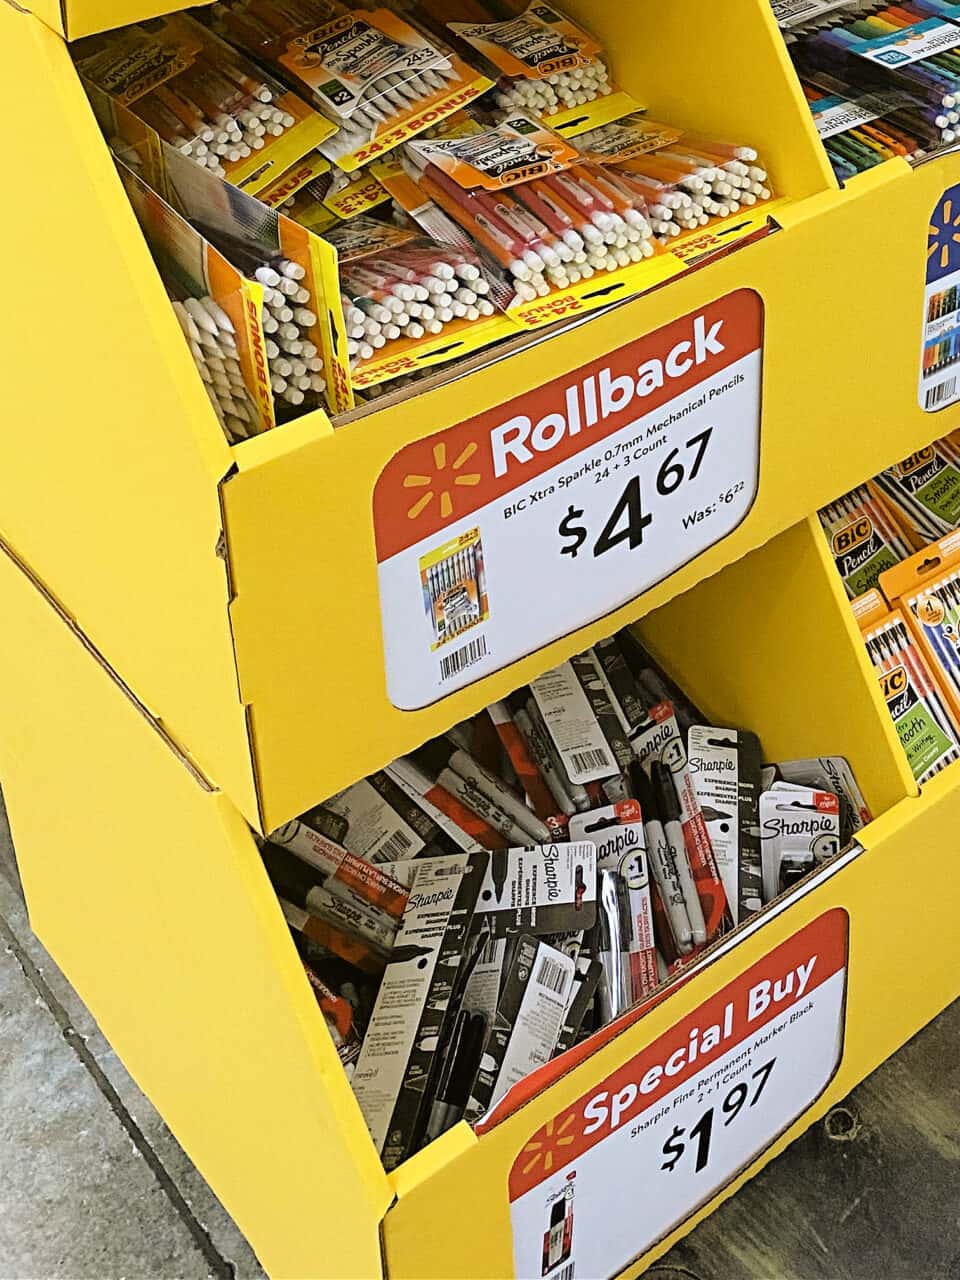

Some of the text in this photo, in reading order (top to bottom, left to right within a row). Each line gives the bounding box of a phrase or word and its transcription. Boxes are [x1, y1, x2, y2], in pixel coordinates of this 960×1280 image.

[353, 88, 480, 162] 24+3 BONUS
[490, 315, 725, 479] Rollback
[504, 373, 745, 520] BIC Xtra Sparkle 0.7mm Mechanical Pencils
[594, 435, 668, 485] 24 Count
[909, 460, 942, 490] Pencil
[682, 503, 718, 532] Was:
[843, 538, 878, 571] Pencil
[689, 758, 735, 774] Sharpie
[760, 816, 835, 840] Sharpie
[541, 844, 560, 901] Sharpie
[403, 888, 454, 913] Sharpie
[583, 954, 818, 1136] Special Buy
[631, 1001, 815, 1138] Sharpie Fine Permanent Marker Black
[722, 1060, 752, 1084] Count
